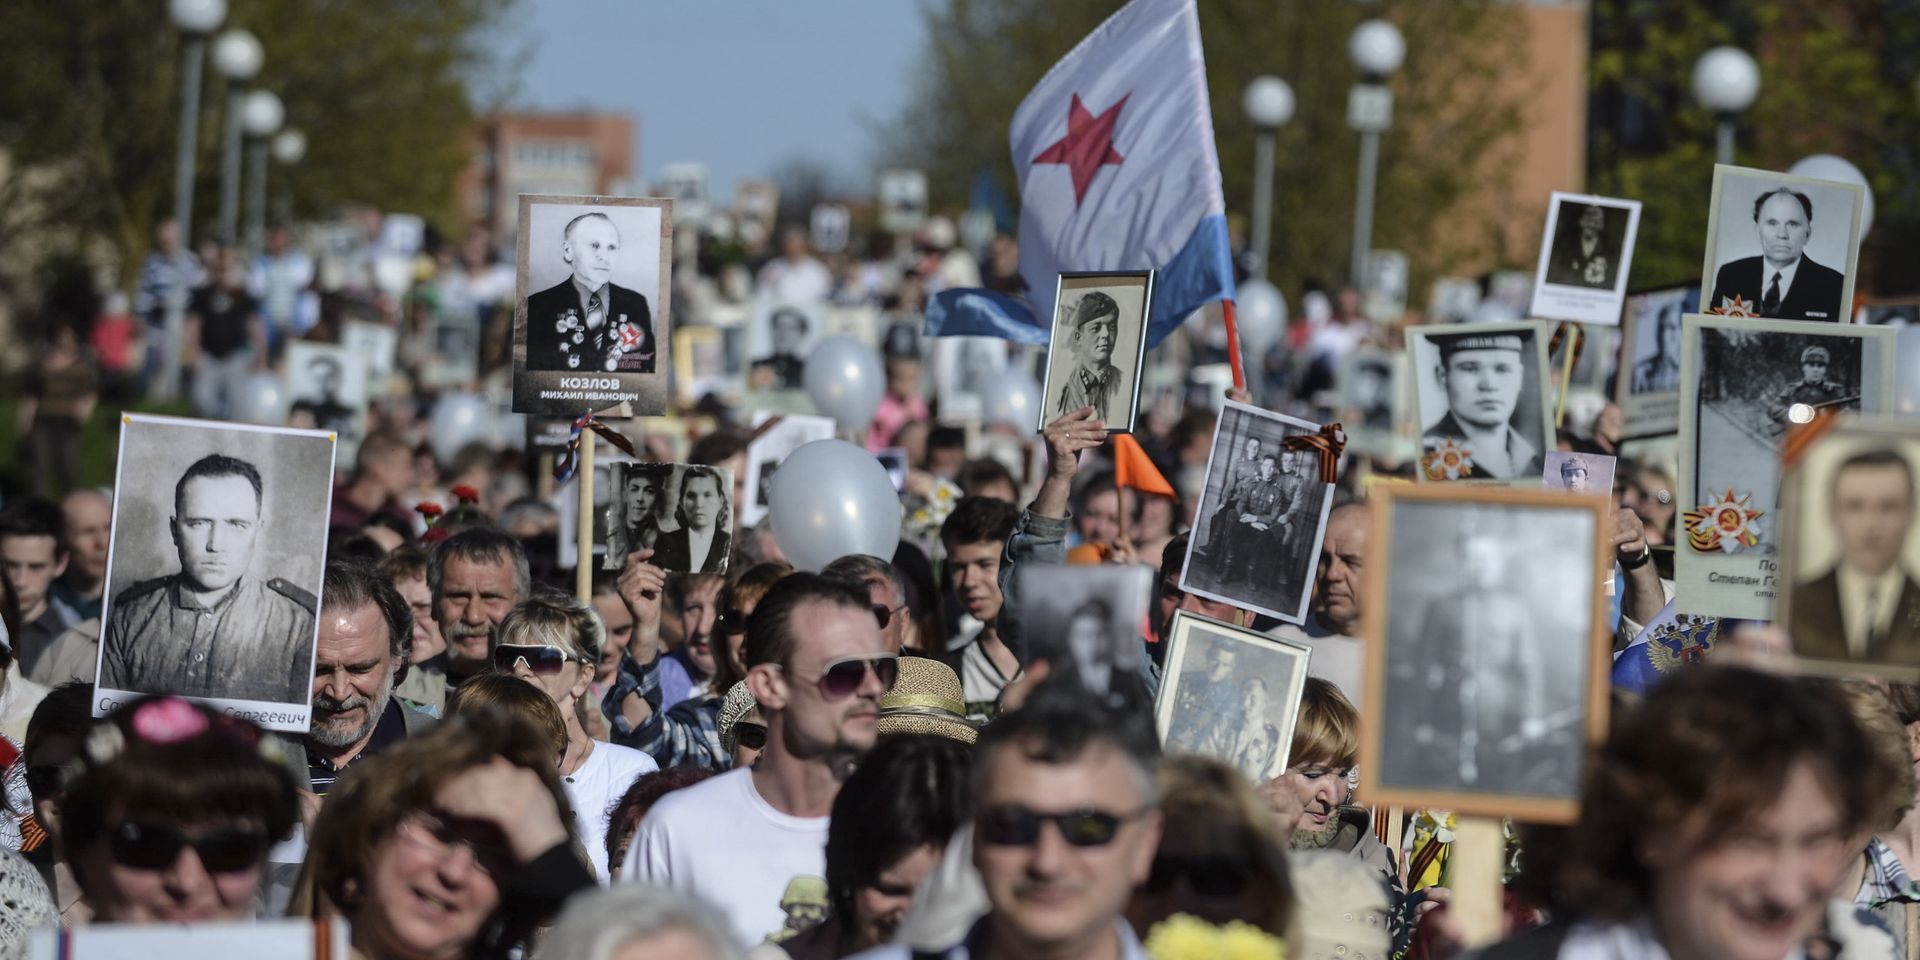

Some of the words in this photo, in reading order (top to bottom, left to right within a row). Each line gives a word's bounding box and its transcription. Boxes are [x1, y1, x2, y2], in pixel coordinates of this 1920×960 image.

[561, 378, 621, 390] КОЗЛОВ
[540, 390, 583, 400] МИХАИЛ
[585, 392, 639, 401] ИВАНОВИЧ
[1709, 571, 1760, 585] Степан
